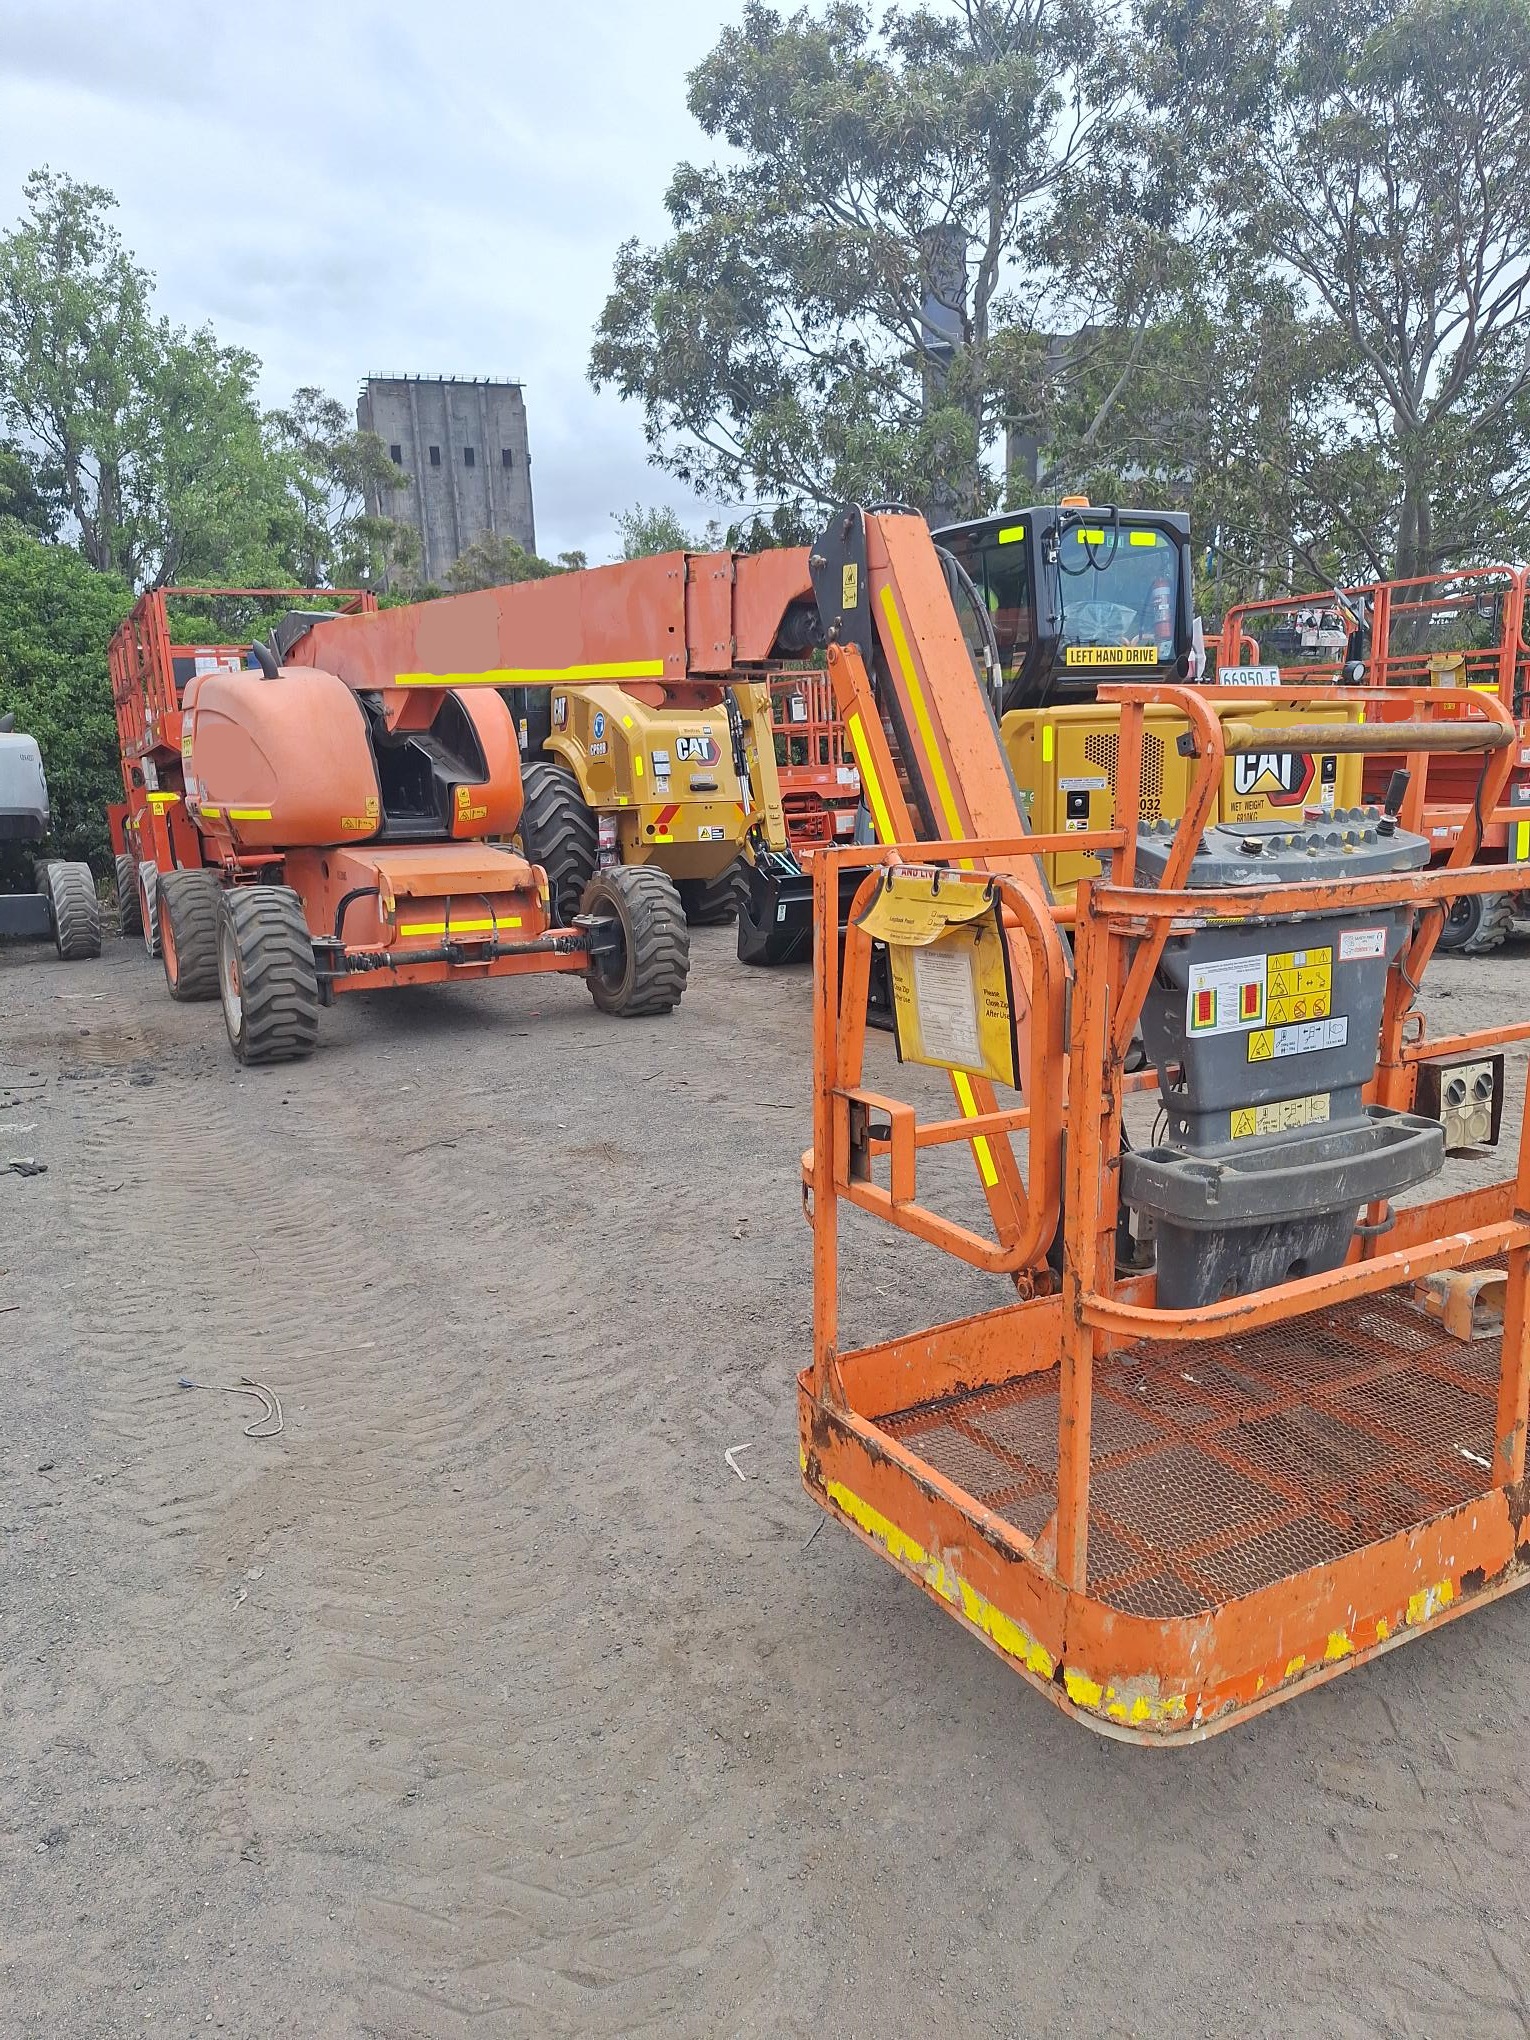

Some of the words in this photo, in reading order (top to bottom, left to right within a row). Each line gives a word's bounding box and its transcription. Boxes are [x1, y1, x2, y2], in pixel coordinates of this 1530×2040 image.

[1070, 650, 1092, 663] LEFT
[1096, 650, 1123, 662] HAND
[1126, 649, 1154, 662] DRIVE
[554, 697, 566, 725] CAT
[676, 737, 709, 761] CAT
[1235, 753, 1291, 794] CAT
[1230, 802, 1242, 811] WET
[1244, 800, 1264, 810] WEIGHT
[983, 988, 1000, 998] Please
[986, 999, 1000, 1007] Close
[986, 1009, 1000, 1018] After
[1000, 1012, 1011, 1020] Use
